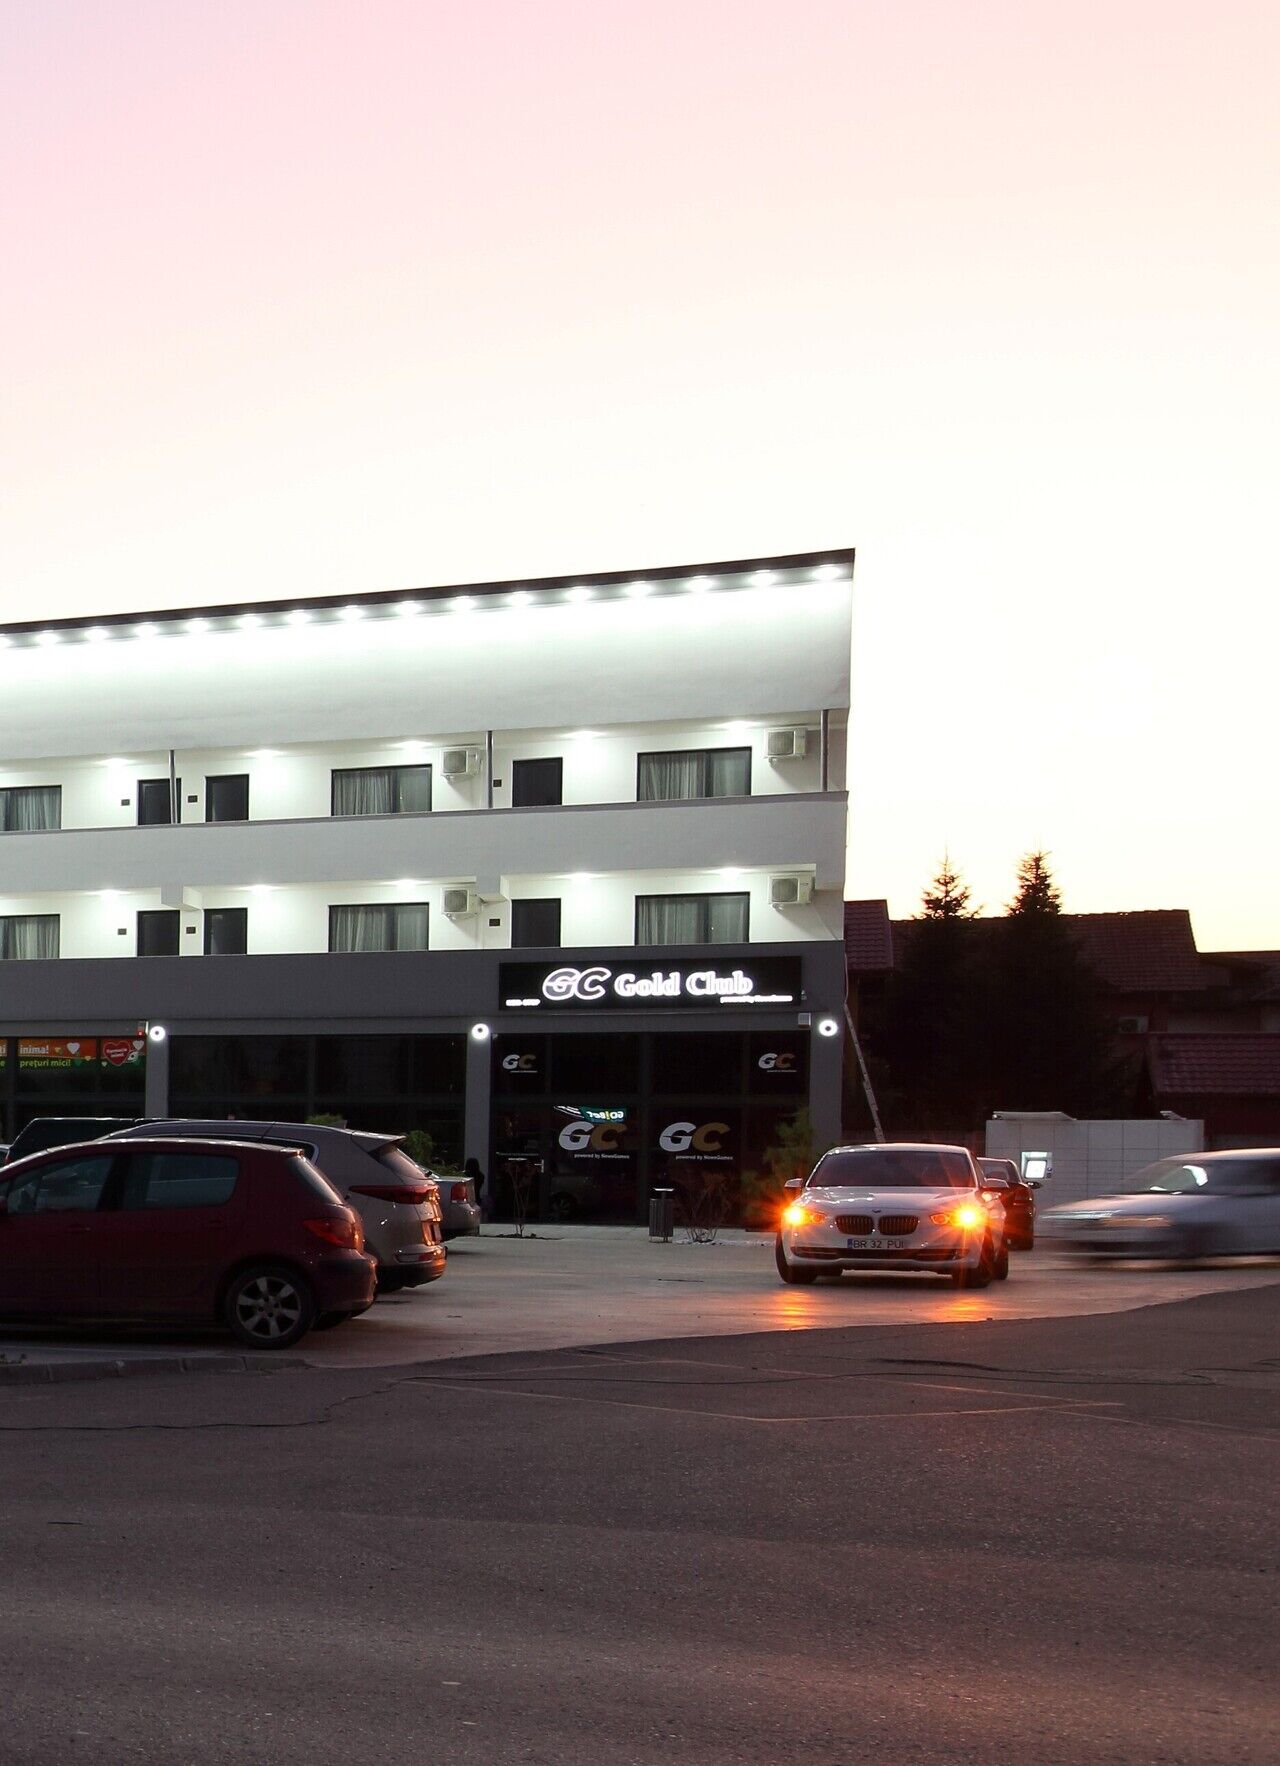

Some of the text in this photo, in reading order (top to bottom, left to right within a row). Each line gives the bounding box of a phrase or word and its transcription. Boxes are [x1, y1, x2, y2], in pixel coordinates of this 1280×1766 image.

[542, 967, 754, 1000] GC Gold Club
[20, 1045, 49, 1054] inima!
[503, 1054, 537, 1069] GC
[758, 1053, 795, 1069] GC
[558, 1121, 627, 1151] GC
[659, 1122, 730, 1152] GC
[853, 1240, 867, 1249] BR
[870, 1240, 882, 1249] 32
